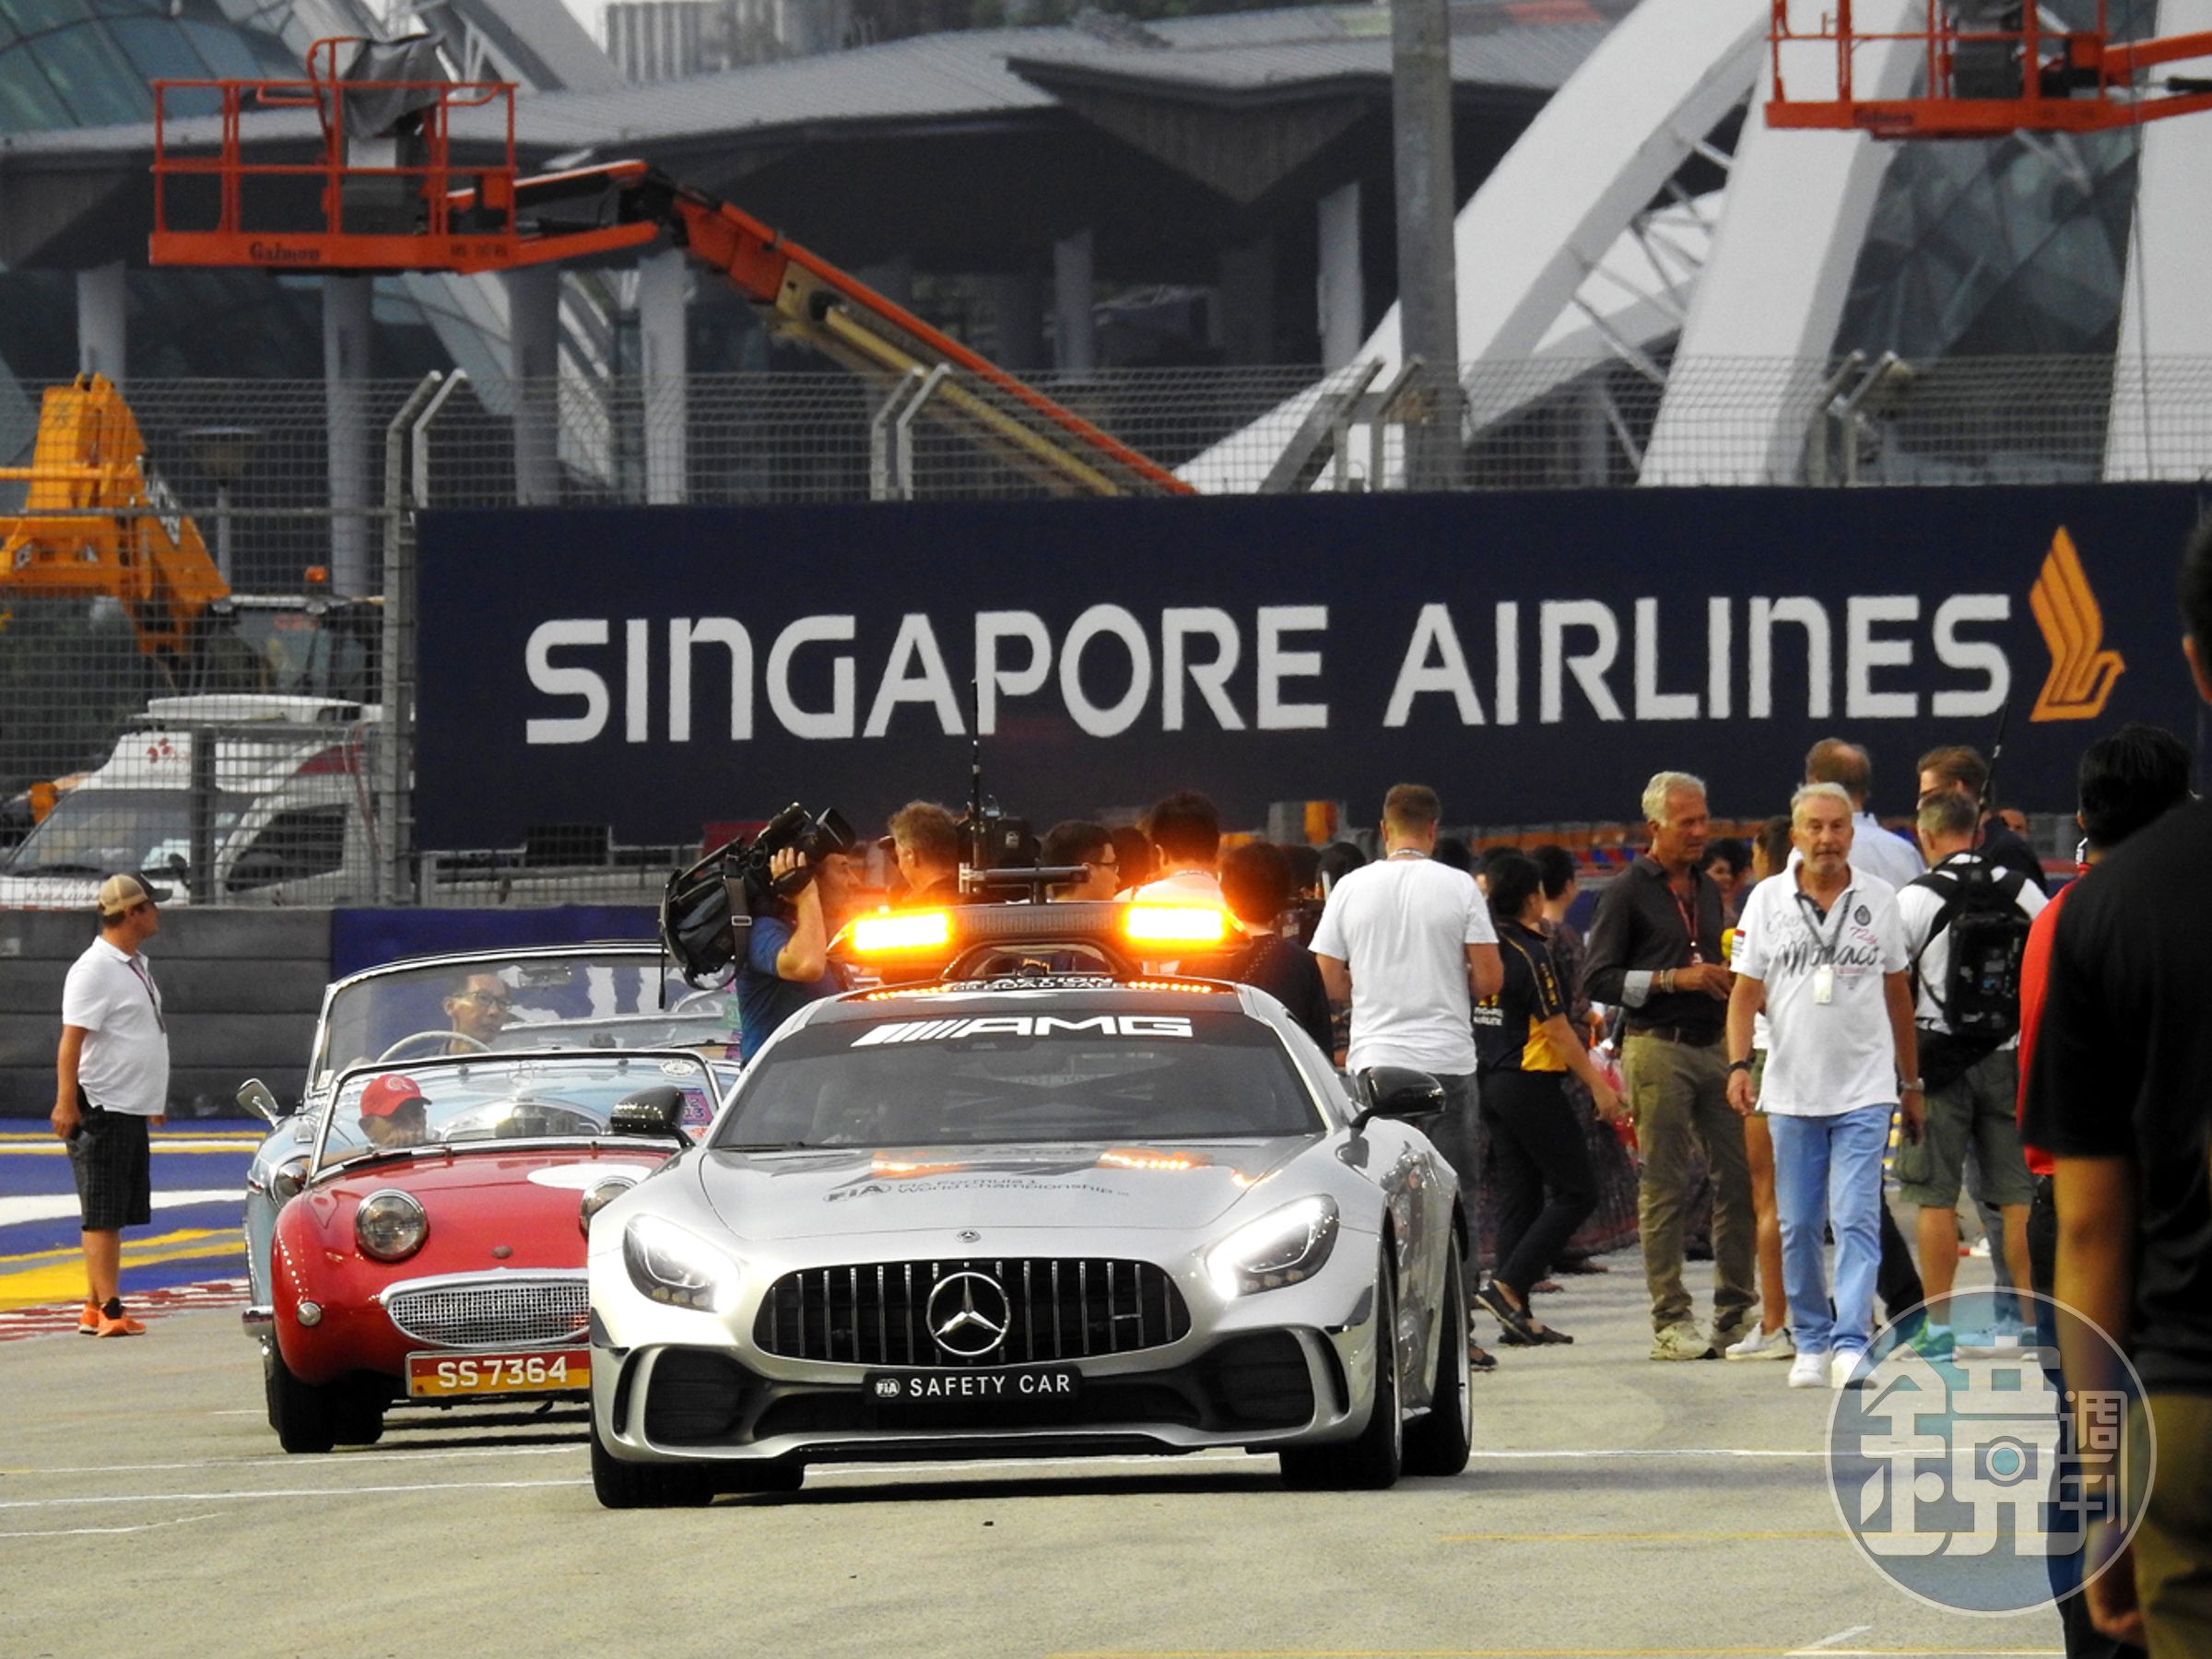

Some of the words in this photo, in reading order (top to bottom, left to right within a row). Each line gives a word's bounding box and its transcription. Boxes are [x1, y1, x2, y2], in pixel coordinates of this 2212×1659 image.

[524, 604, 1329, 744] SINGAPORE
[1382, 594, 2012, 727] AIRLINES
[949, 1017, 1194, 1039] AMG
[875, 1380, 899, 1396] FIA
[910, 1375, 1006, 1396] SAFETY
[1019, 1374, 1071, 1393] CAR
